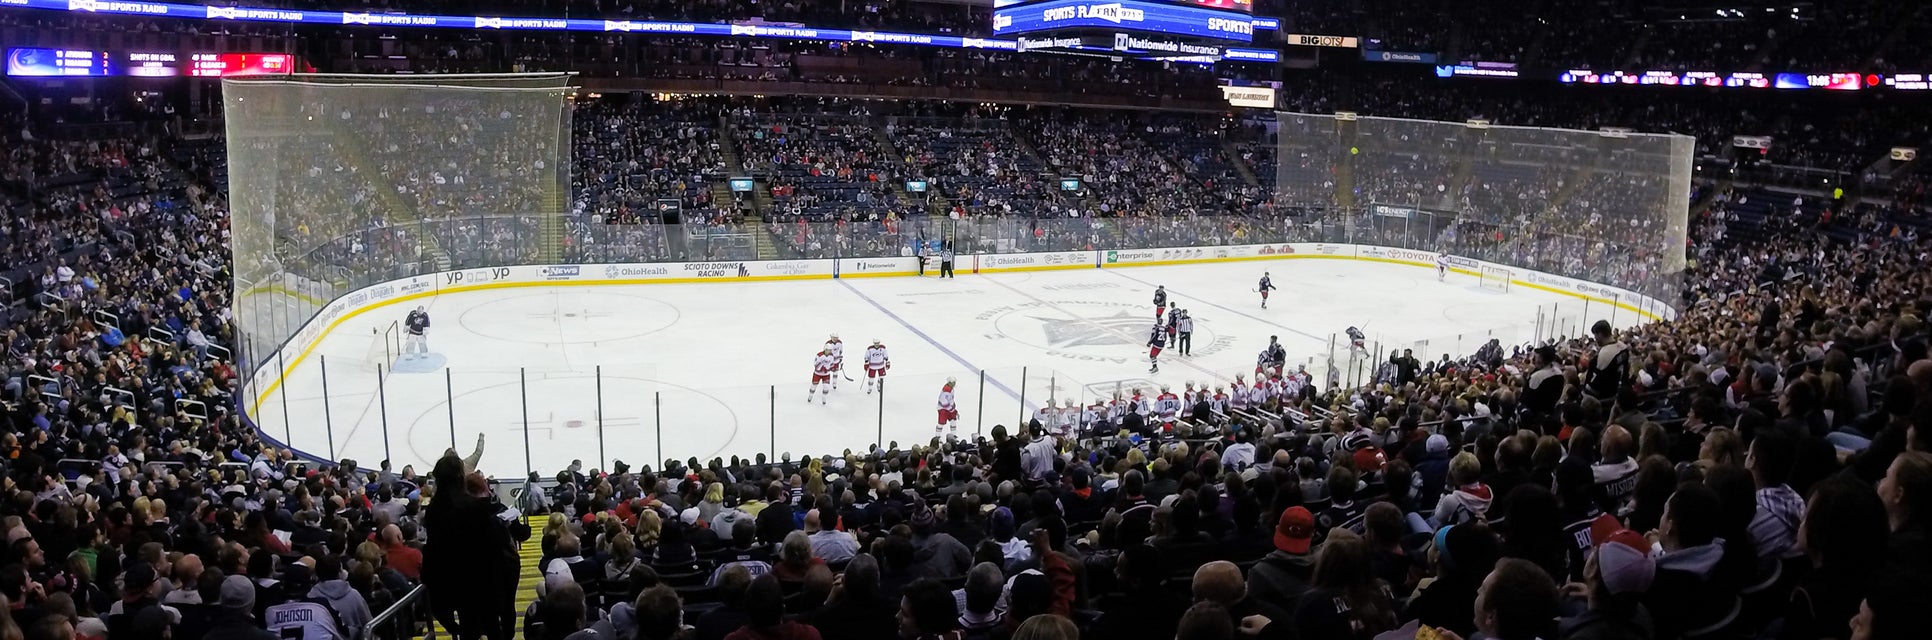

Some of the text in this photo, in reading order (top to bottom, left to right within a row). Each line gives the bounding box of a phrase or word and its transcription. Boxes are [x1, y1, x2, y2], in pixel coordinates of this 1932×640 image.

[110, 2, 142, 11] SPORTS
[142, 5, 168, 13] RADIO
[248, 11, 278, 19] SPORTS
[279, 12, 303, 20] RADIO
[1044, 6, 1075, 21] SPORTS
[382, 16, 411, 24] SPORTS
[412, 17, 437, 25] RADIO
[1208, 18, 1251, 34] SPORTS
[886, 34, 910, 42] SPORTS
[911, 35, 932, 43] RADIO
[1026, 38, 1081, 49] Nationwide Insurance
[1129, 38, 1178, 51] Nationwide
[1180, 42, 1220, 55] Insurance
[998, 257, 1035, 265] OhioHealth
[1110, 252, 1153, 261] enterprise
[1402, 252, 1435, 262] TOYOTA
[492, 267, 510, 280] yp
[550, 266, 578, 275] NEWS
[621, 267, 668, 276] OhioHealth
[446, 271, 464, 285] yp
[274, 608, 313, 625] JOHNSON
